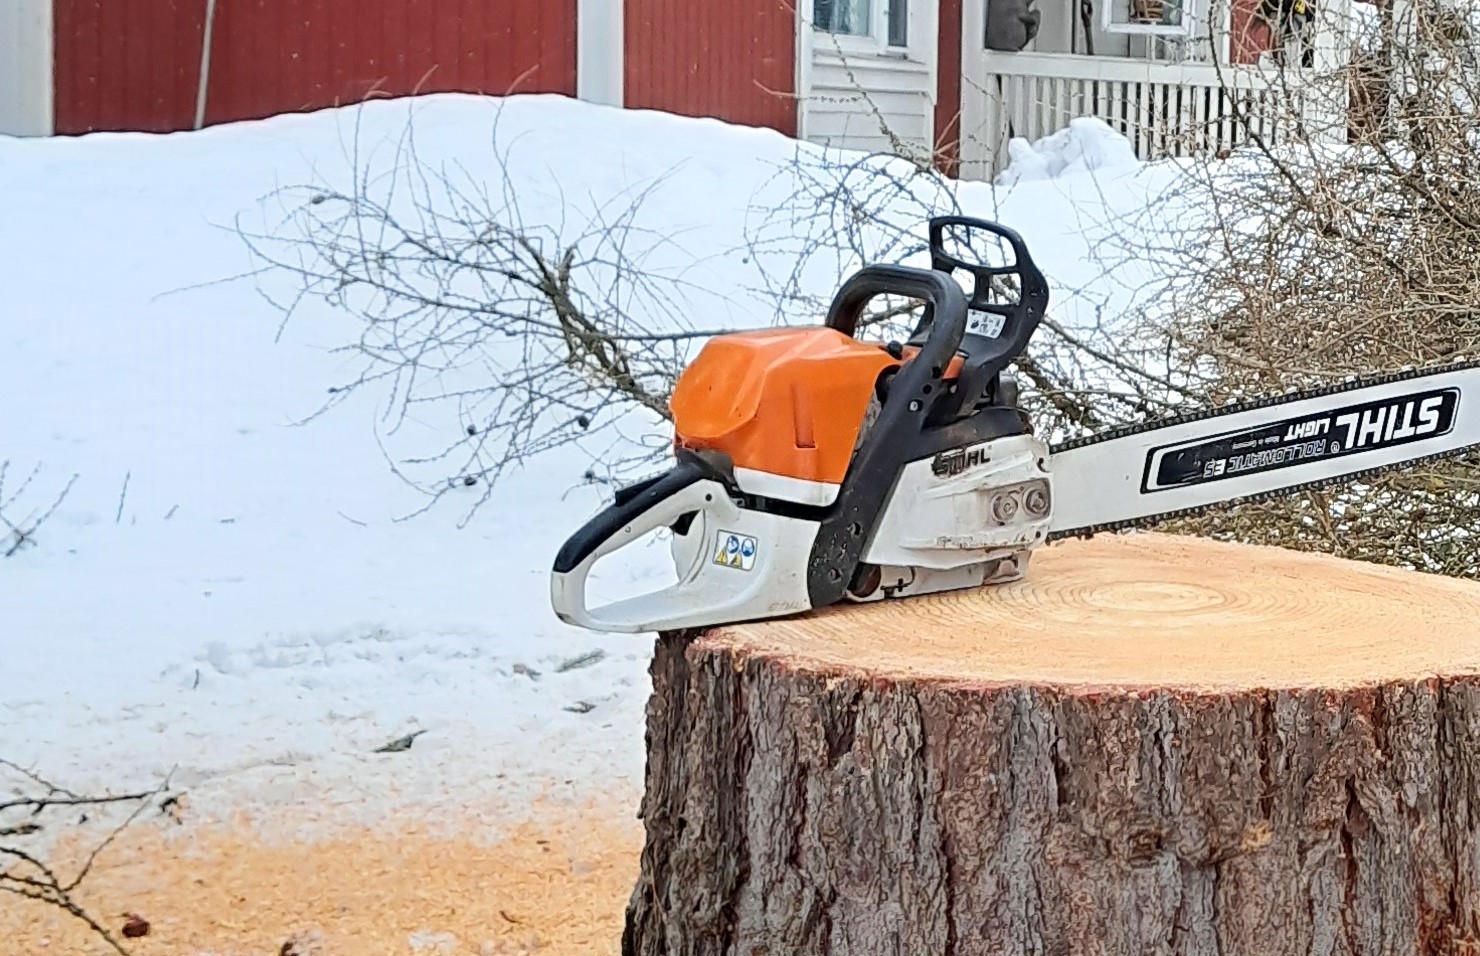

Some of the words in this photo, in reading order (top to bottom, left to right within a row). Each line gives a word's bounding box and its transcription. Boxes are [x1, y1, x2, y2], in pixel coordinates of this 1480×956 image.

[1283, 418, 1331, 442] LIGHT
[1335, 396, 1443, 450] STIHL
[1227, 439, 1326, 473] ROLLOMATIC
